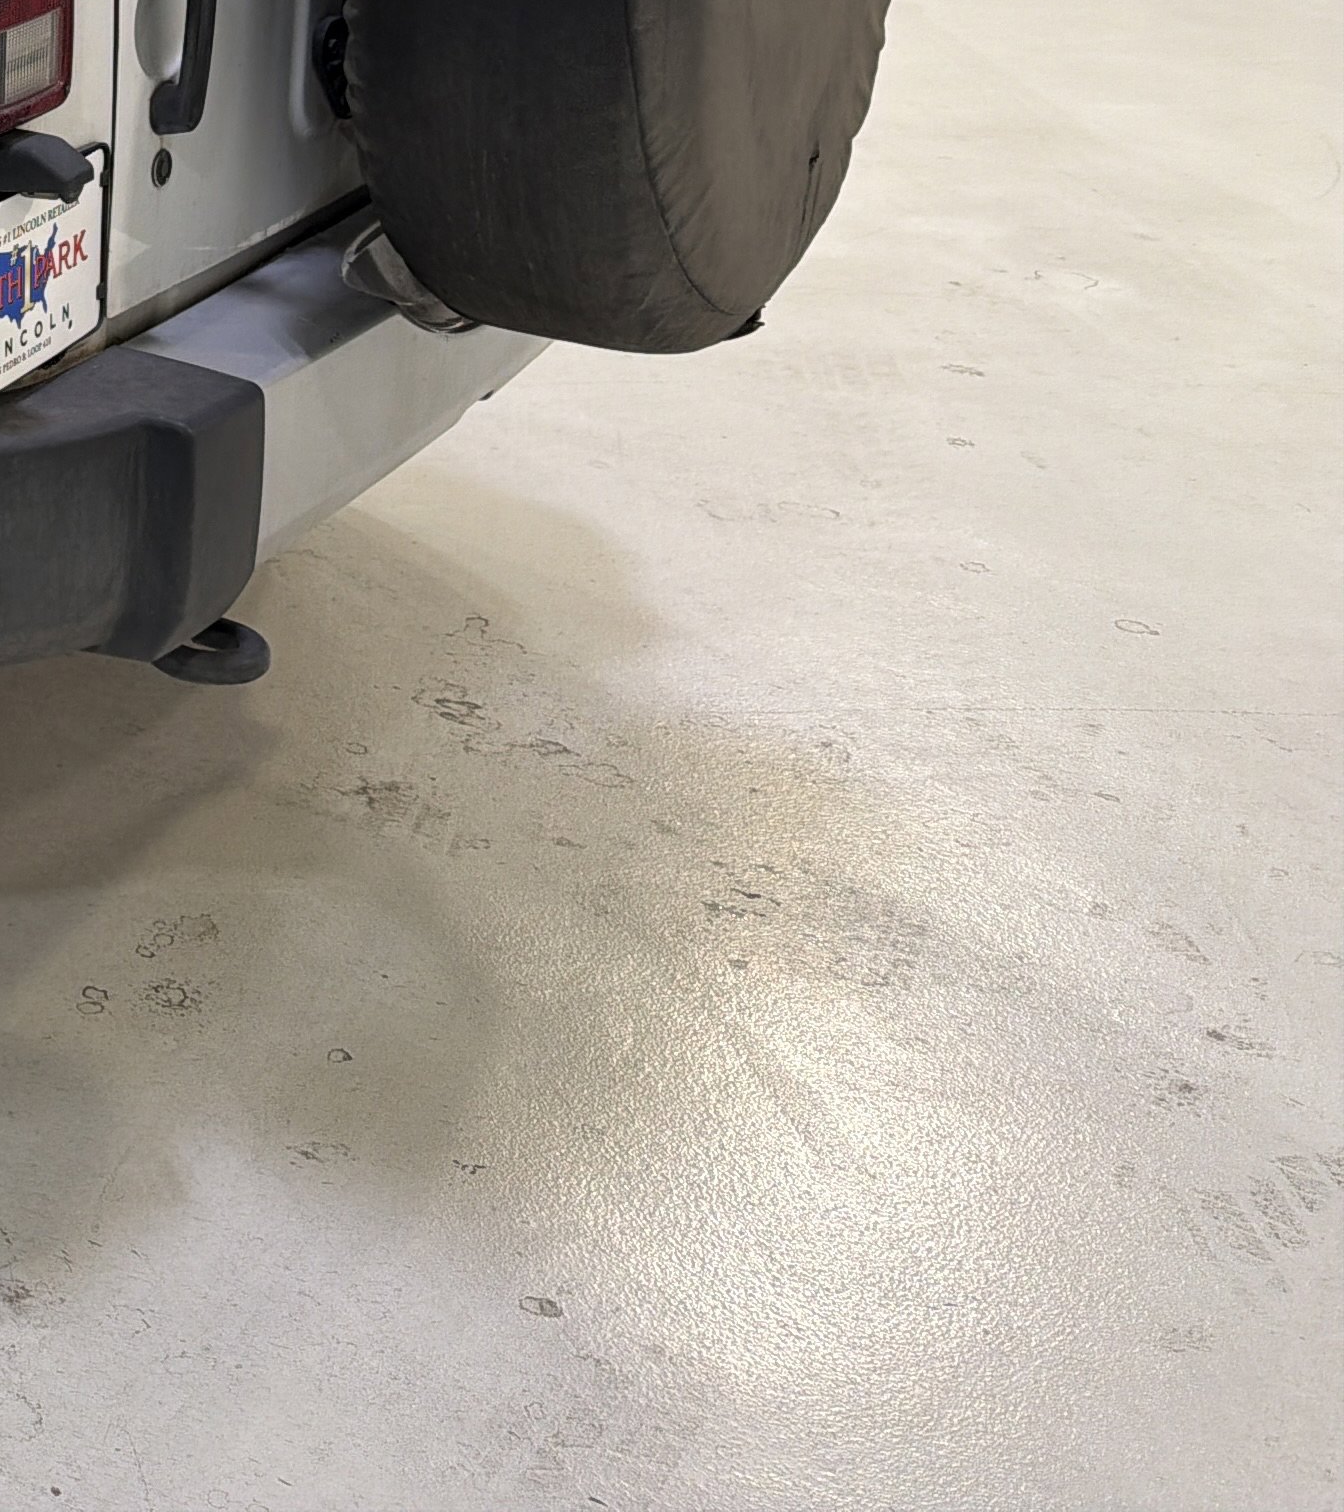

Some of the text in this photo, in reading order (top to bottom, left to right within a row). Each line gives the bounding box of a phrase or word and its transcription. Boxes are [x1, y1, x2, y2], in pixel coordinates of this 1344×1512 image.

[12, 212, 47, 241] LINCOLN
[34, 229, 88, 289] PARK
[3, 355, 22, 373] PEDRO
